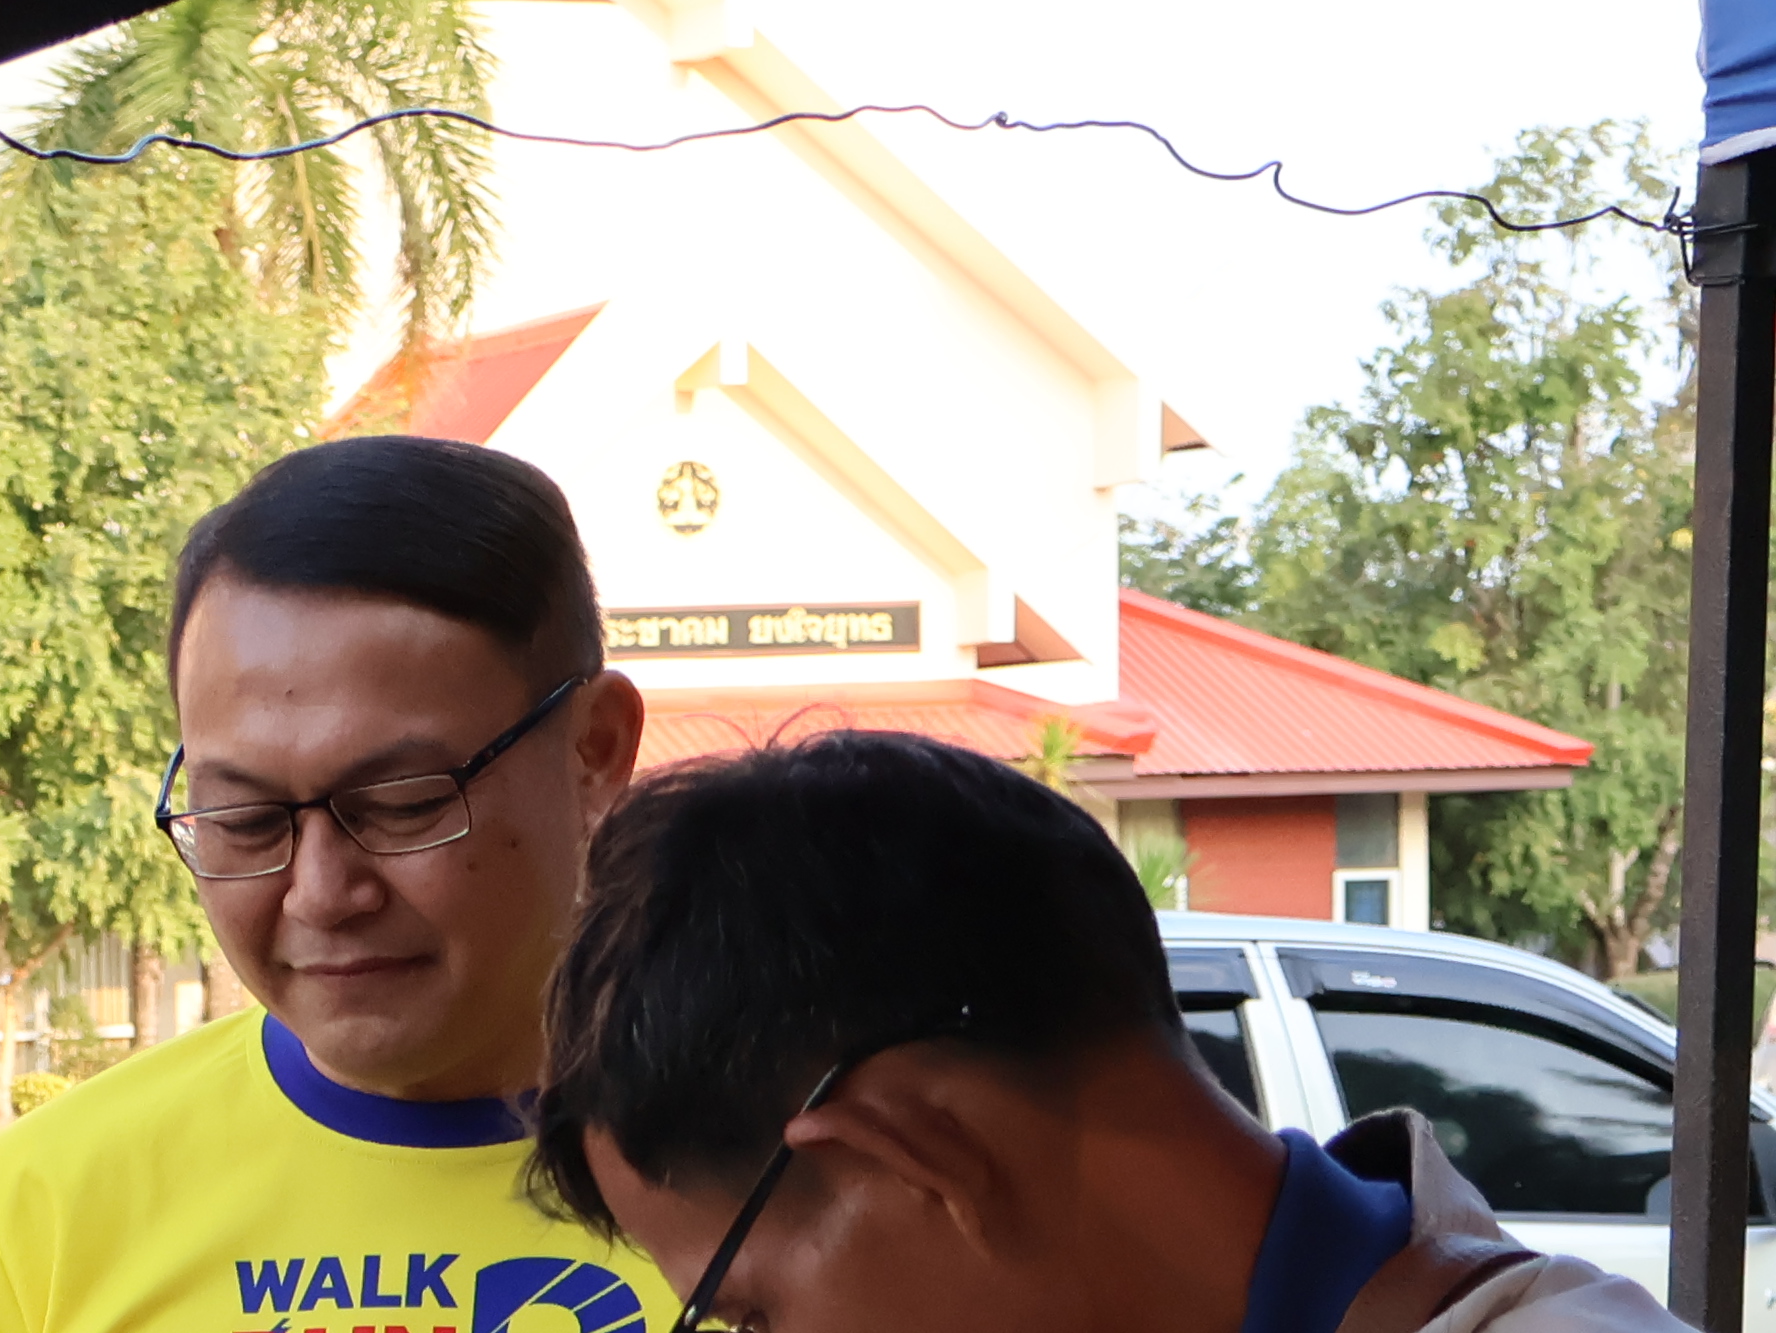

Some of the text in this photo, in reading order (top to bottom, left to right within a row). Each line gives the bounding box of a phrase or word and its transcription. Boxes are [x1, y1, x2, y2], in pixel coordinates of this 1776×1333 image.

[603, 615, 730, 648] ระชาคม
[234, 1253, 460, 1314] WALK
